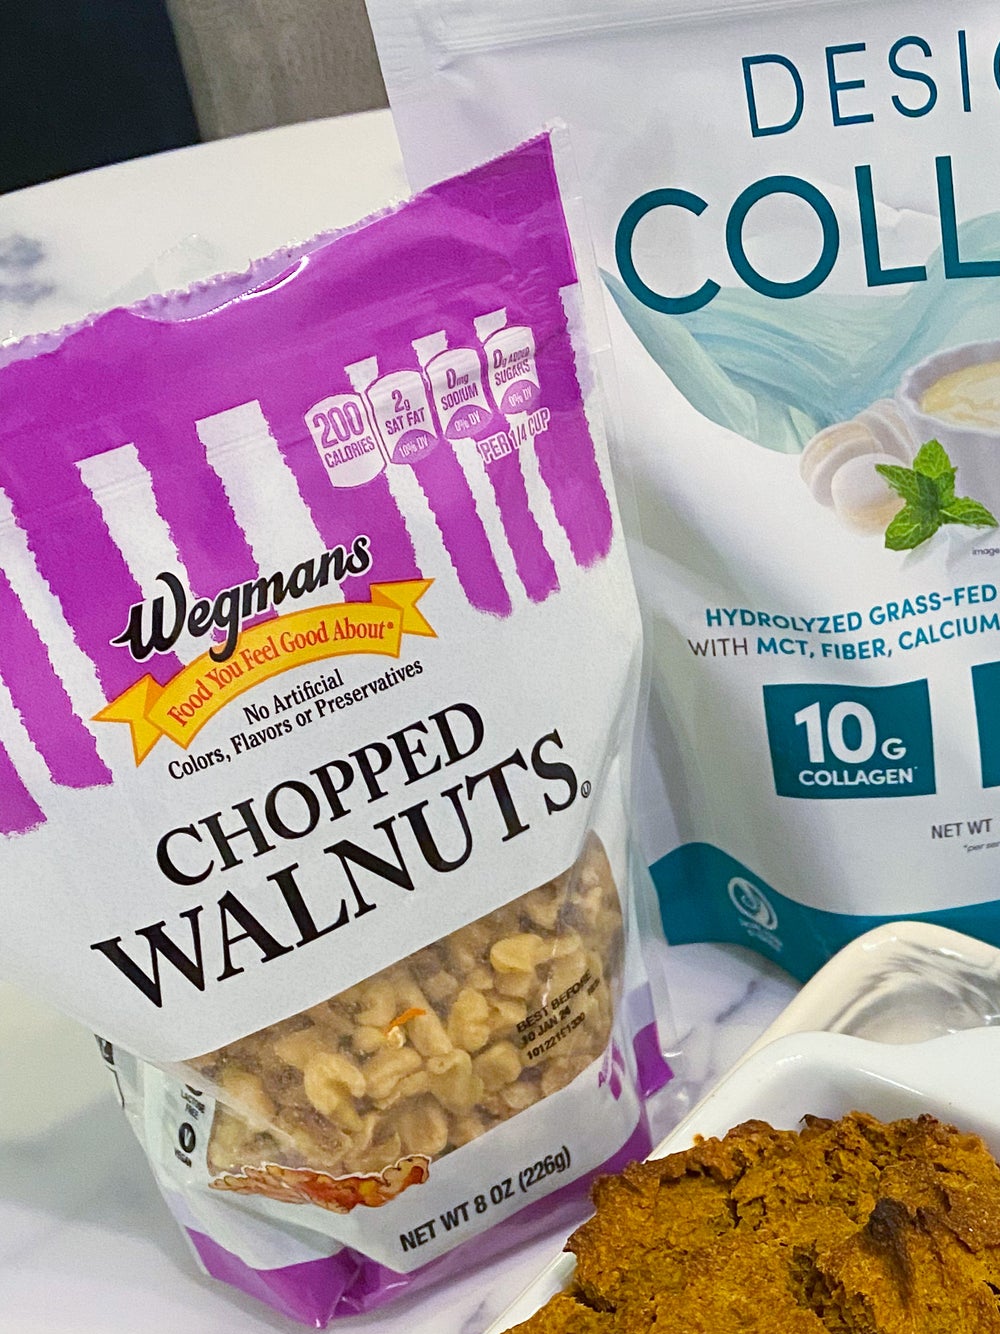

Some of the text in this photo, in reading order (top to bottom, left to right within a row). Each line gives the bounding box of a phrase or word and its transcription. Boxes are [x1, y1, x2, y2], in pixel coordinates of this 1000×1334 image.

[446, 368, 469, 389] 0mg
[494, 358, 531, 386] SUGARS
[391, 389, 411, 413] 2g
[441, 383, 479, 411] SODIUM
[312, 401, 364, 448] 200
[385, 407, 425, 435] SAT FAT
[480, 408, 549, 462] PER 1/4 CUP
[324, 436, 375, 468] CALORIES
[972, 547, 1000, 556] image
[112, 536, 370, 663] Wegmans
[705, 608, 862, 633] HYDROLYZED
[869, 583, 998, 625] GRASS-FED
[687, 637, 748, 657] WITH
[757, 637, 815, 659] MCT,
[822, 638, 892, 660] FIBER,
[167, 616, 386, 727] Food You Feel Good About
[242, 668, 344, 725] No Artificial
[168, 661, 424, 780] Colors, Flavors or Preservatives
[156, 702, 486, 886] CHOPPED
[798, 768, 913, 786] COLLAGEN
[931, 822, 963, 839] NET
[968, 818, 992, 834] WT
[90, 729, 579, 1008] WALNUTS
[516, 1006, 549, 1033] BEST
[551, 969, 592, 1010] BEFORE
[538, 1016, 558, 1036] JAN
[399, 1145, 571, 1252] NET WT 8 OZ (226g)
